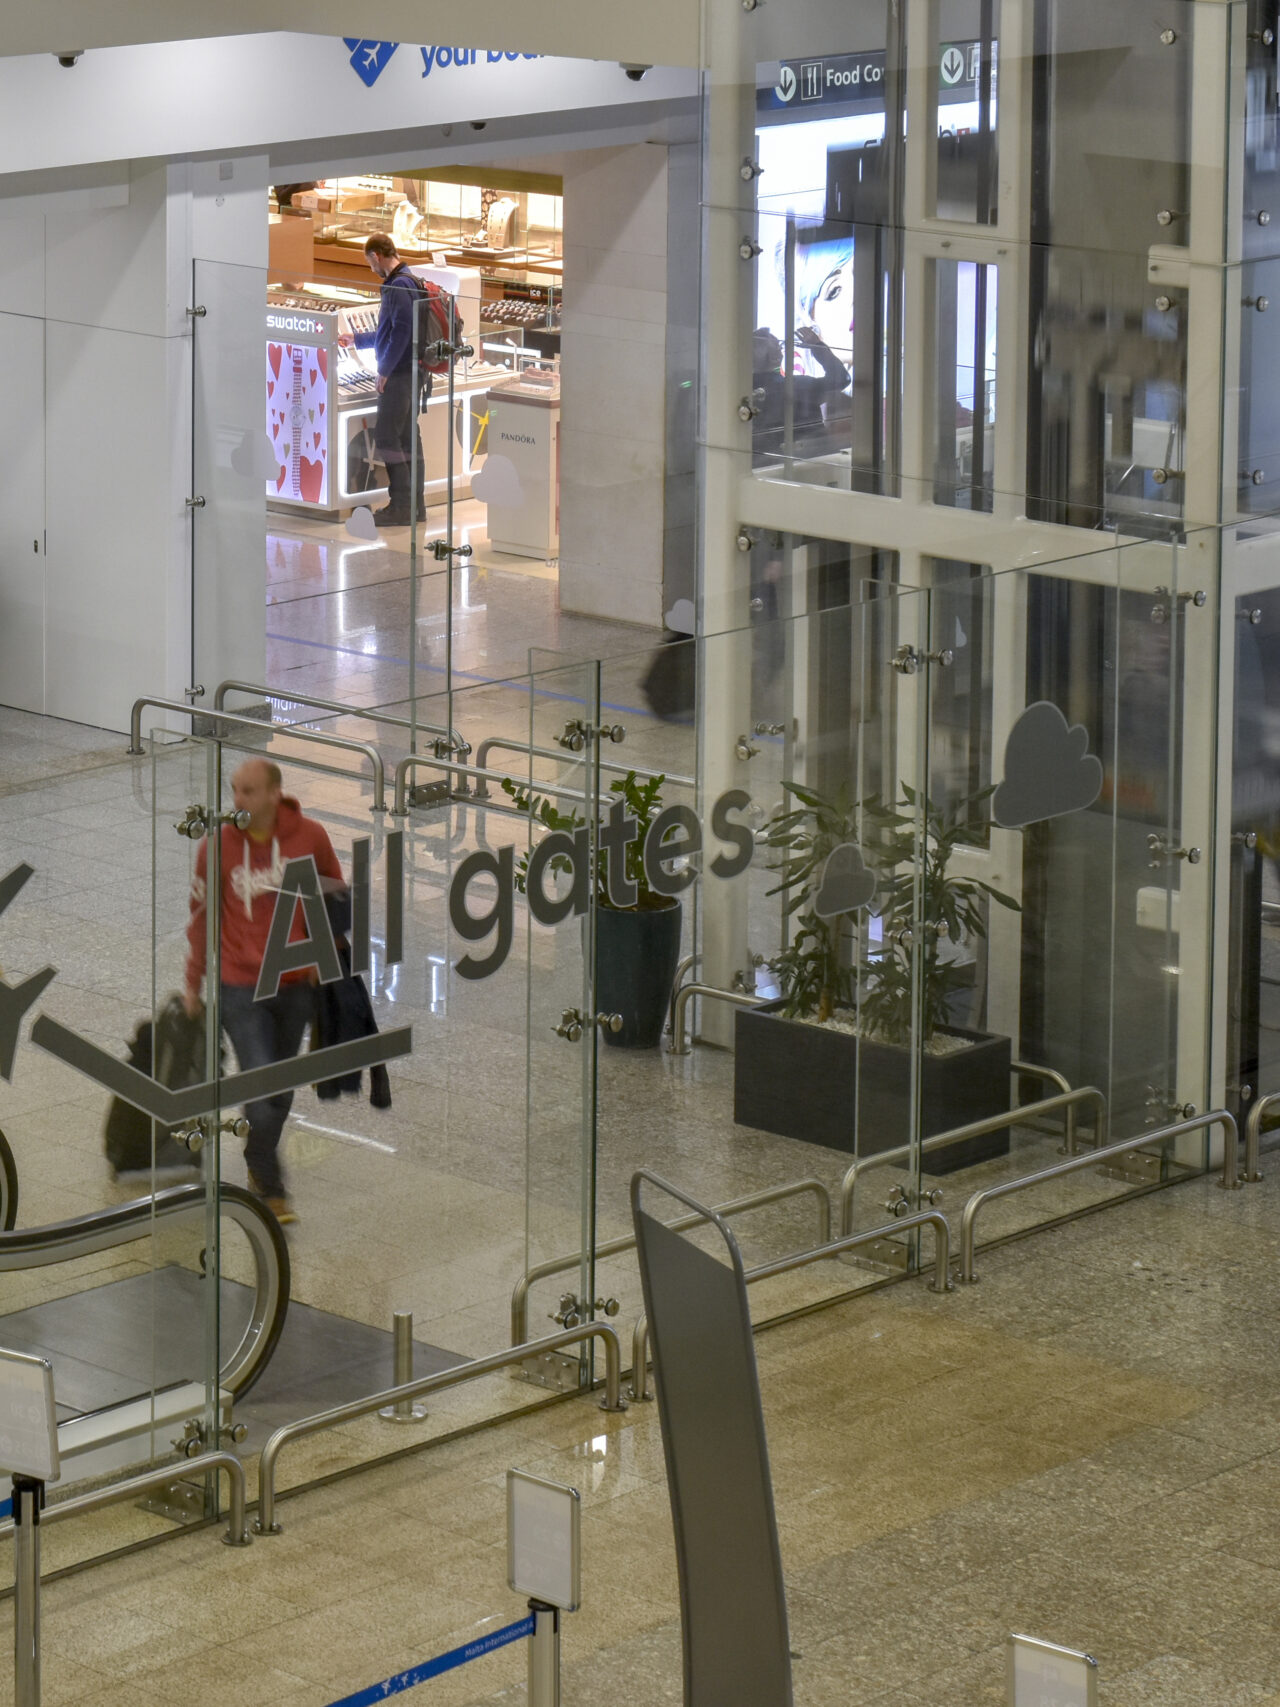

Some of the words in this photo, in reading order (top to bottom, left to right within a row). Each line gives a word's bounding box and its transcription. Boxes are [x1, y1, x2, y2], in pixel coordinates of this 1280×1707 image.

[826, 64, 860, 87] Food
[863, 64, 885, 82] Co
[266, 315, 315, 333] swatch
[501, 432, 536, 445] PANDORA
[253, 830, 404, 1001] All
[449, 788, 755, 980] gates
